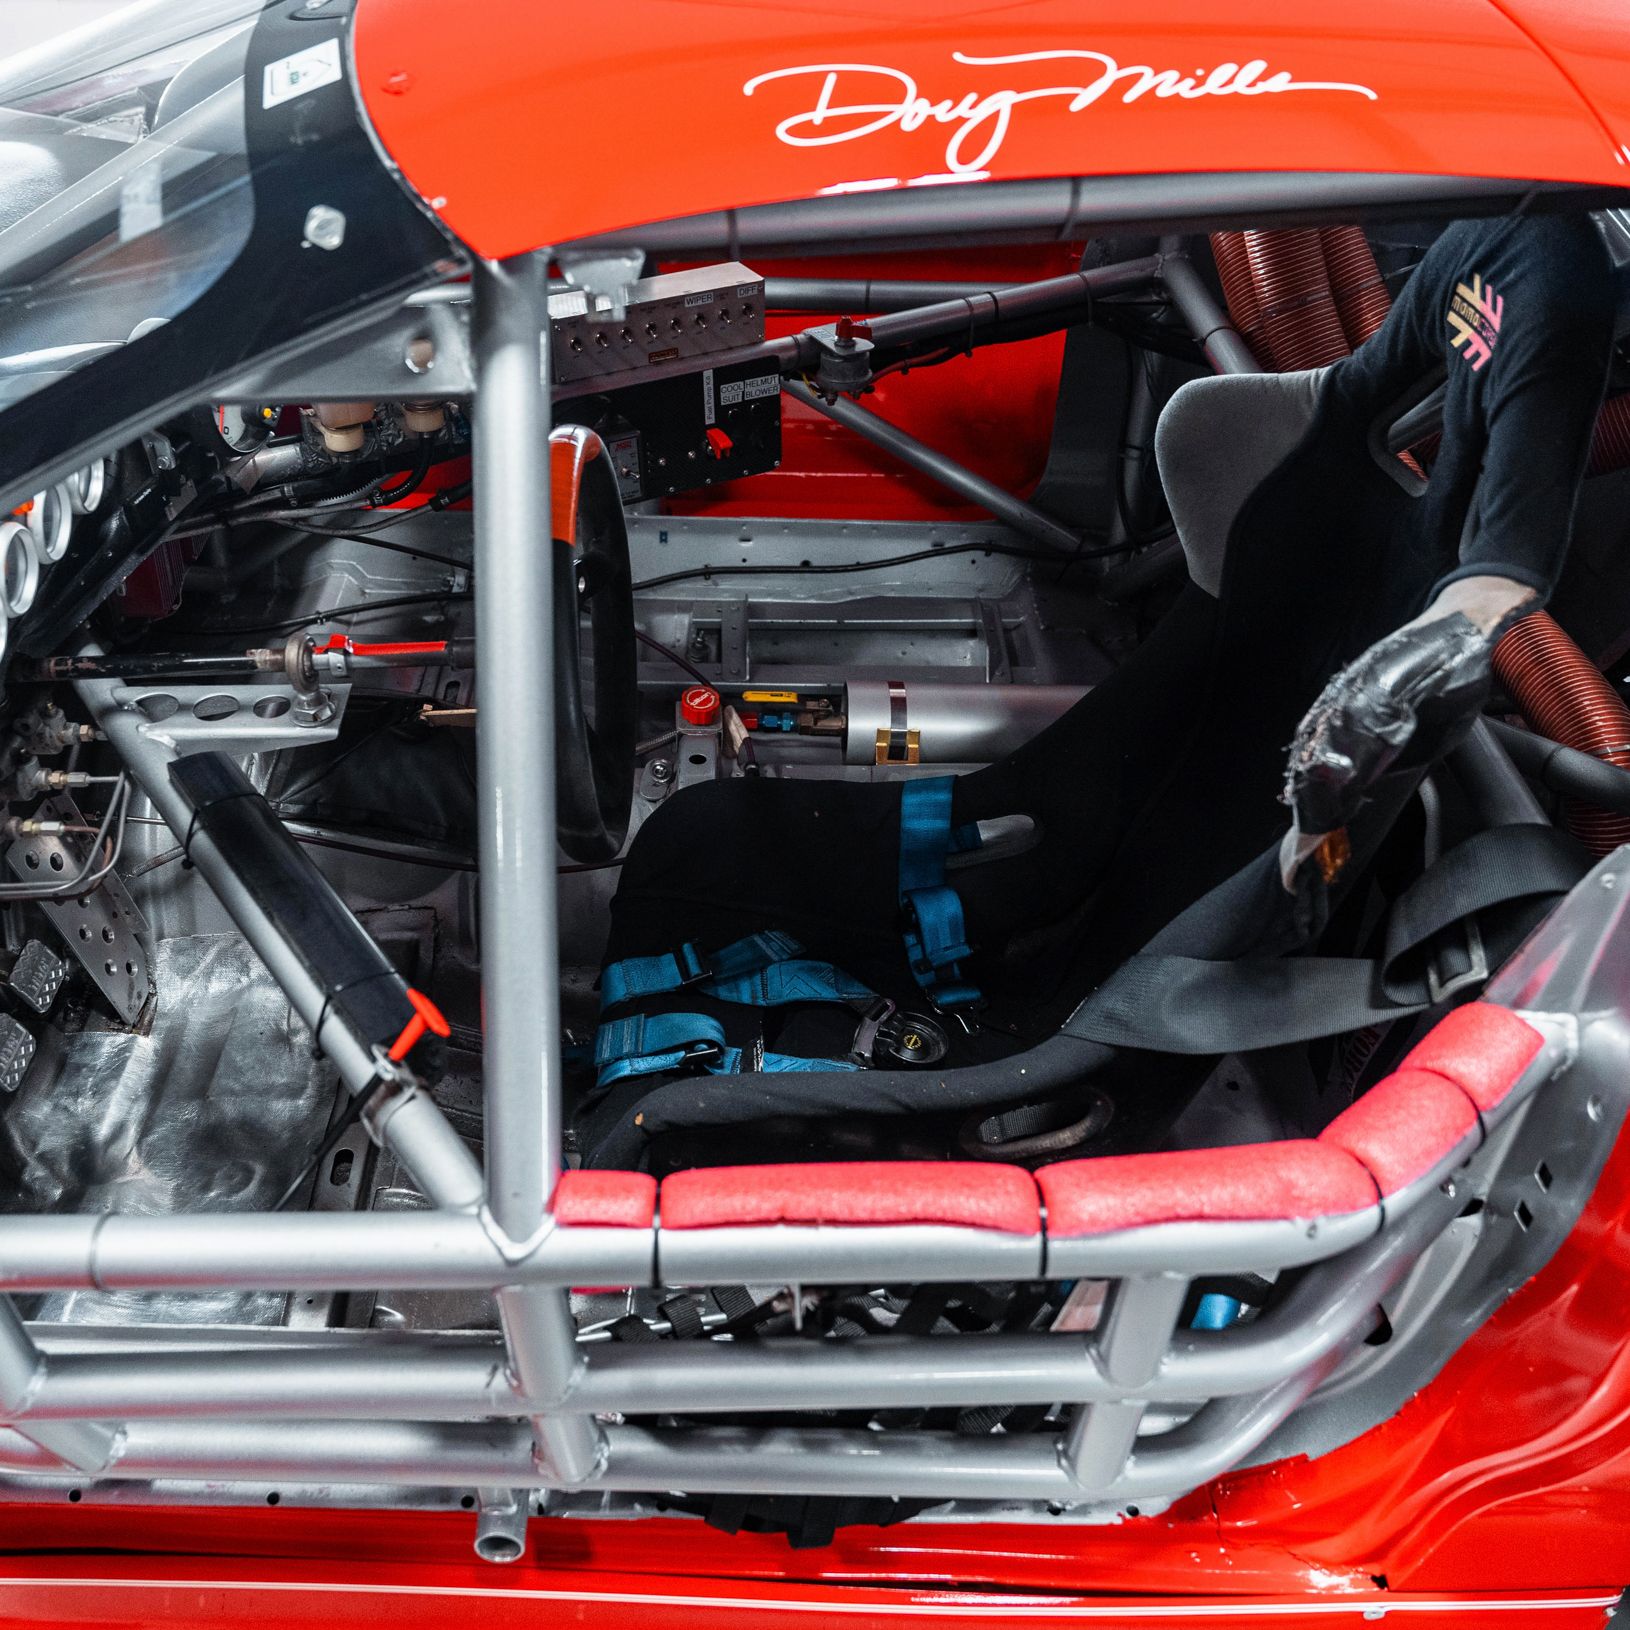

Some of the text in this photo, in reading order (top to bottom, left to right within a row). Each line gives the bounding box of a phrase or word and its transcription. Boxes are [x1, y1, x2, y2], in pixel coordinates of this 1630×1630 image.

[743, 63, 1018, 173] Doug
[739, 285, 757, 296] DIFF
[686, 293, 713, 306] WIPER
[720, 383, 743, 394] COOL
[745, 375, 778, 389] HELMUT
[722, 393, 741, 404] SUIT
[745, 385, 779, 399] BLOWER
